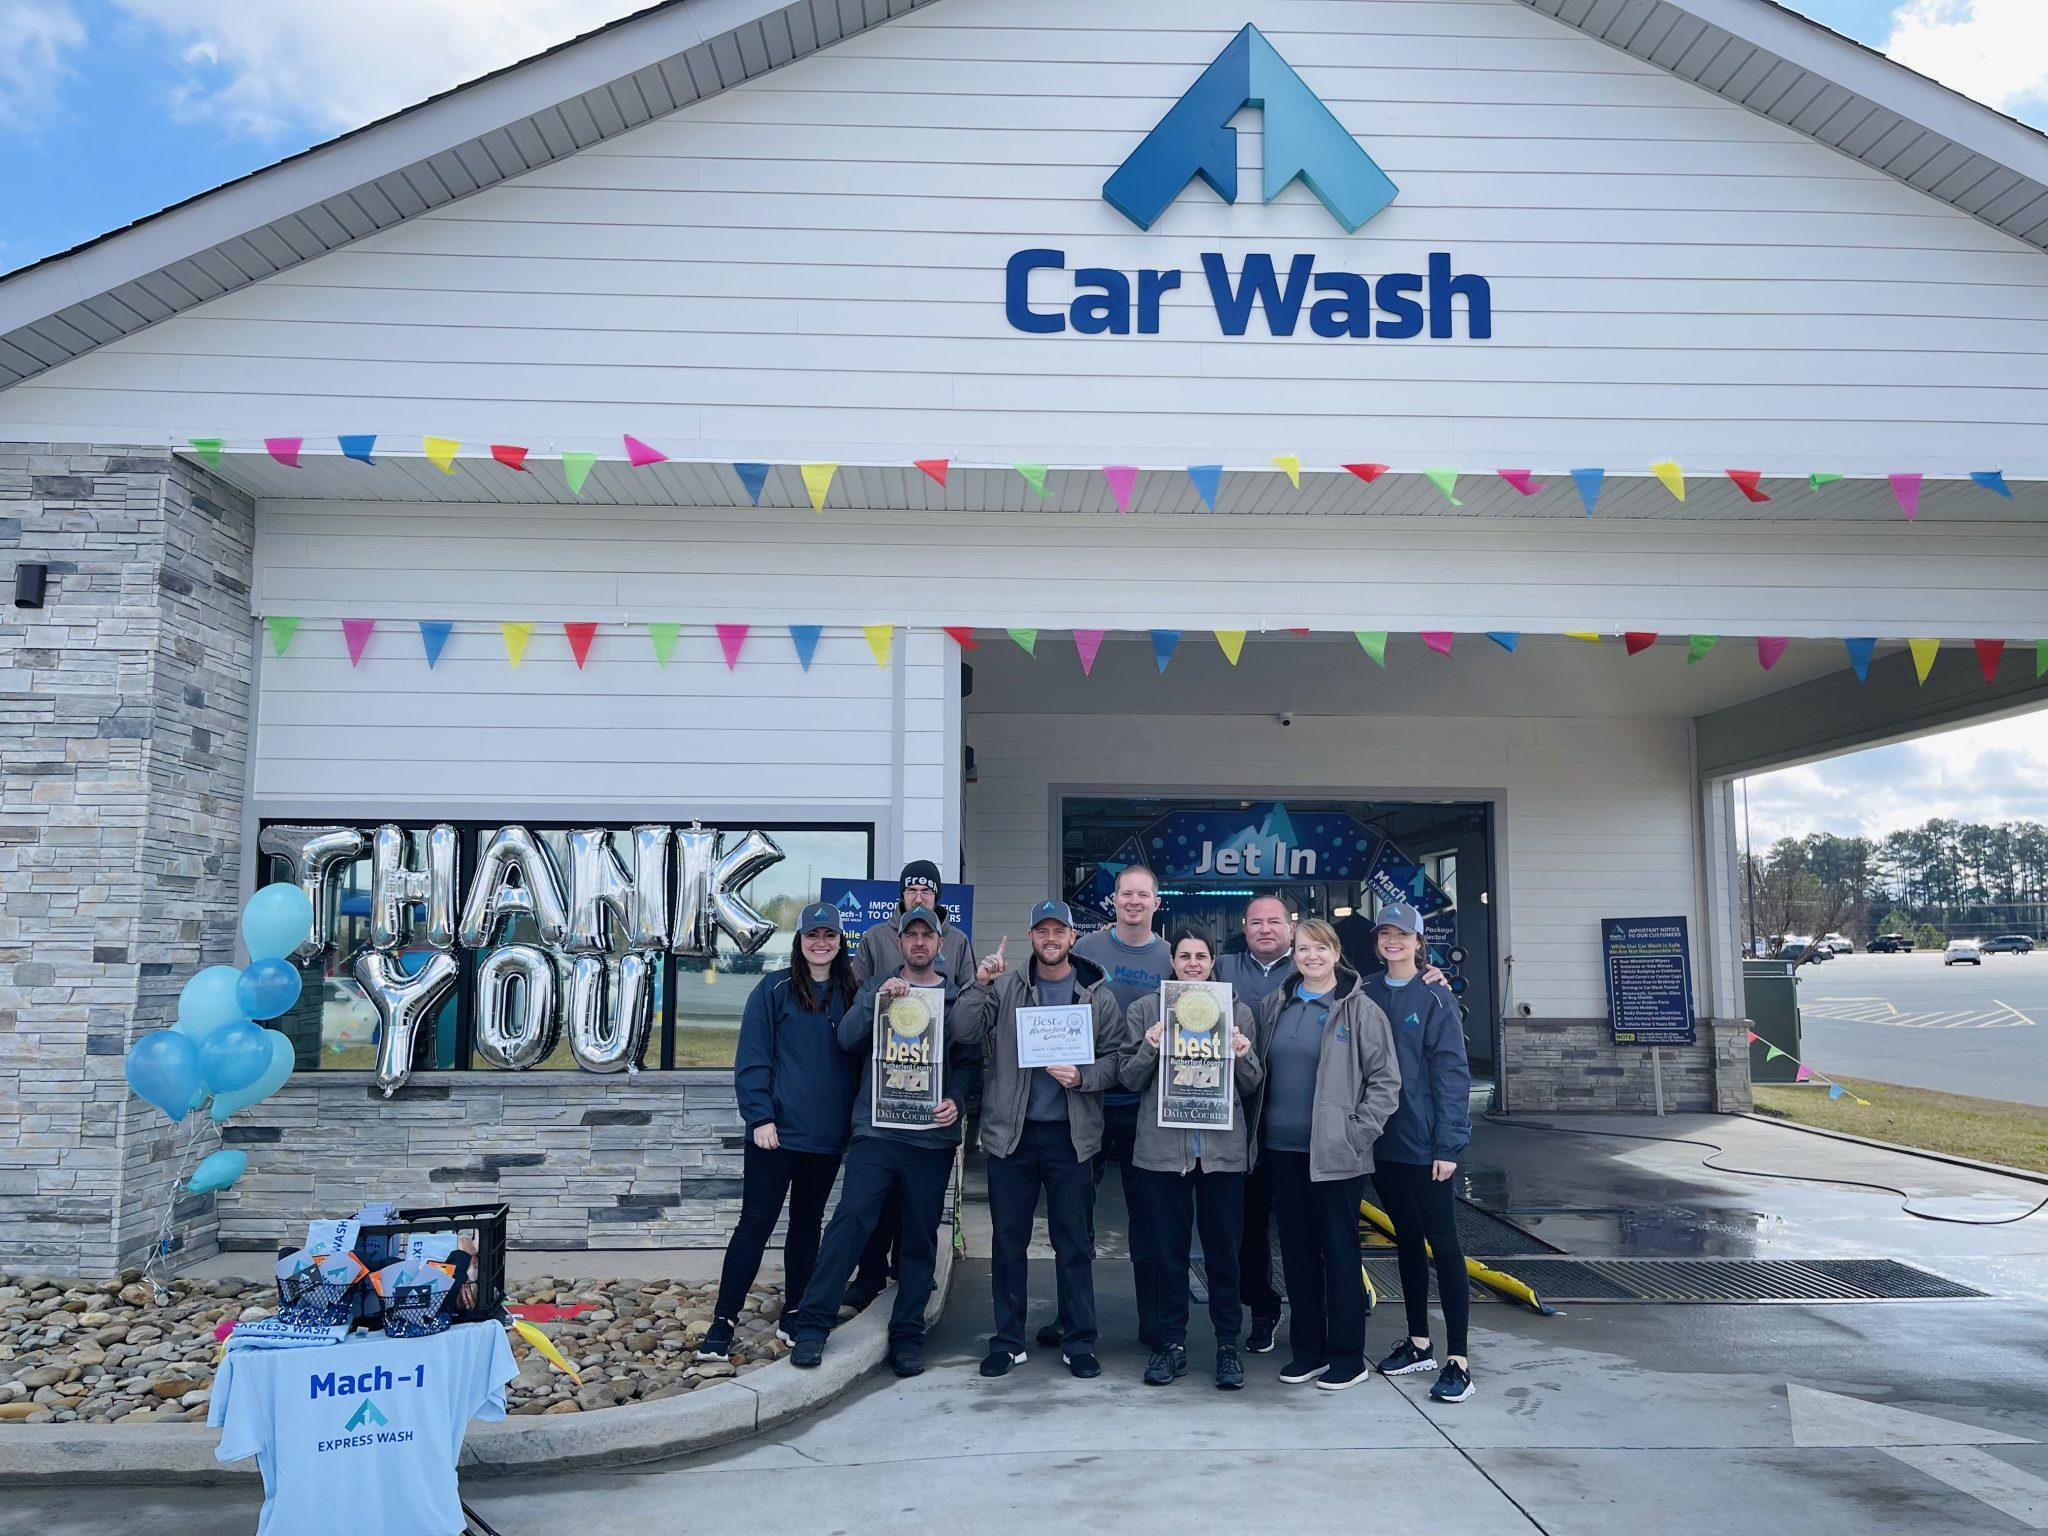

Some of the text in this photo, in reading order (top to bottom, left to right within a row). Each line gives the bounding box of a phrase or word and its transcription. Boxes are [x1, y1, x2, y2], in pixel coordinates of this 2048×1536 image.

[1006, 248, 1492, 339] Car Wash
[1195, 841, 1317, 875] Jet In
[260, 822, 785, 960] THANK
[868, 911, 880, 919] TO
[842, 930, 860, 938] hile
[354, 946, 653, 1095] YOU
[1033, 1016, 1056, 1026] Best
[886, 1028, 930, 1065] best
[1174, 1024, 1221, 1060] best
[883, 1061, 932, 1074] Rutherford County
[1204, 1059, 1224, 1068] County
[877, 1109, 900, 1118] DAILY
[1164, 1108, 1228, 1120] DAILY COURIER
[293, 1325, 330, 1335] WASH
[310, 1364, 424, 1399] Mach-1
[318, 1431, 413, 1452] EXPRESS WASH
